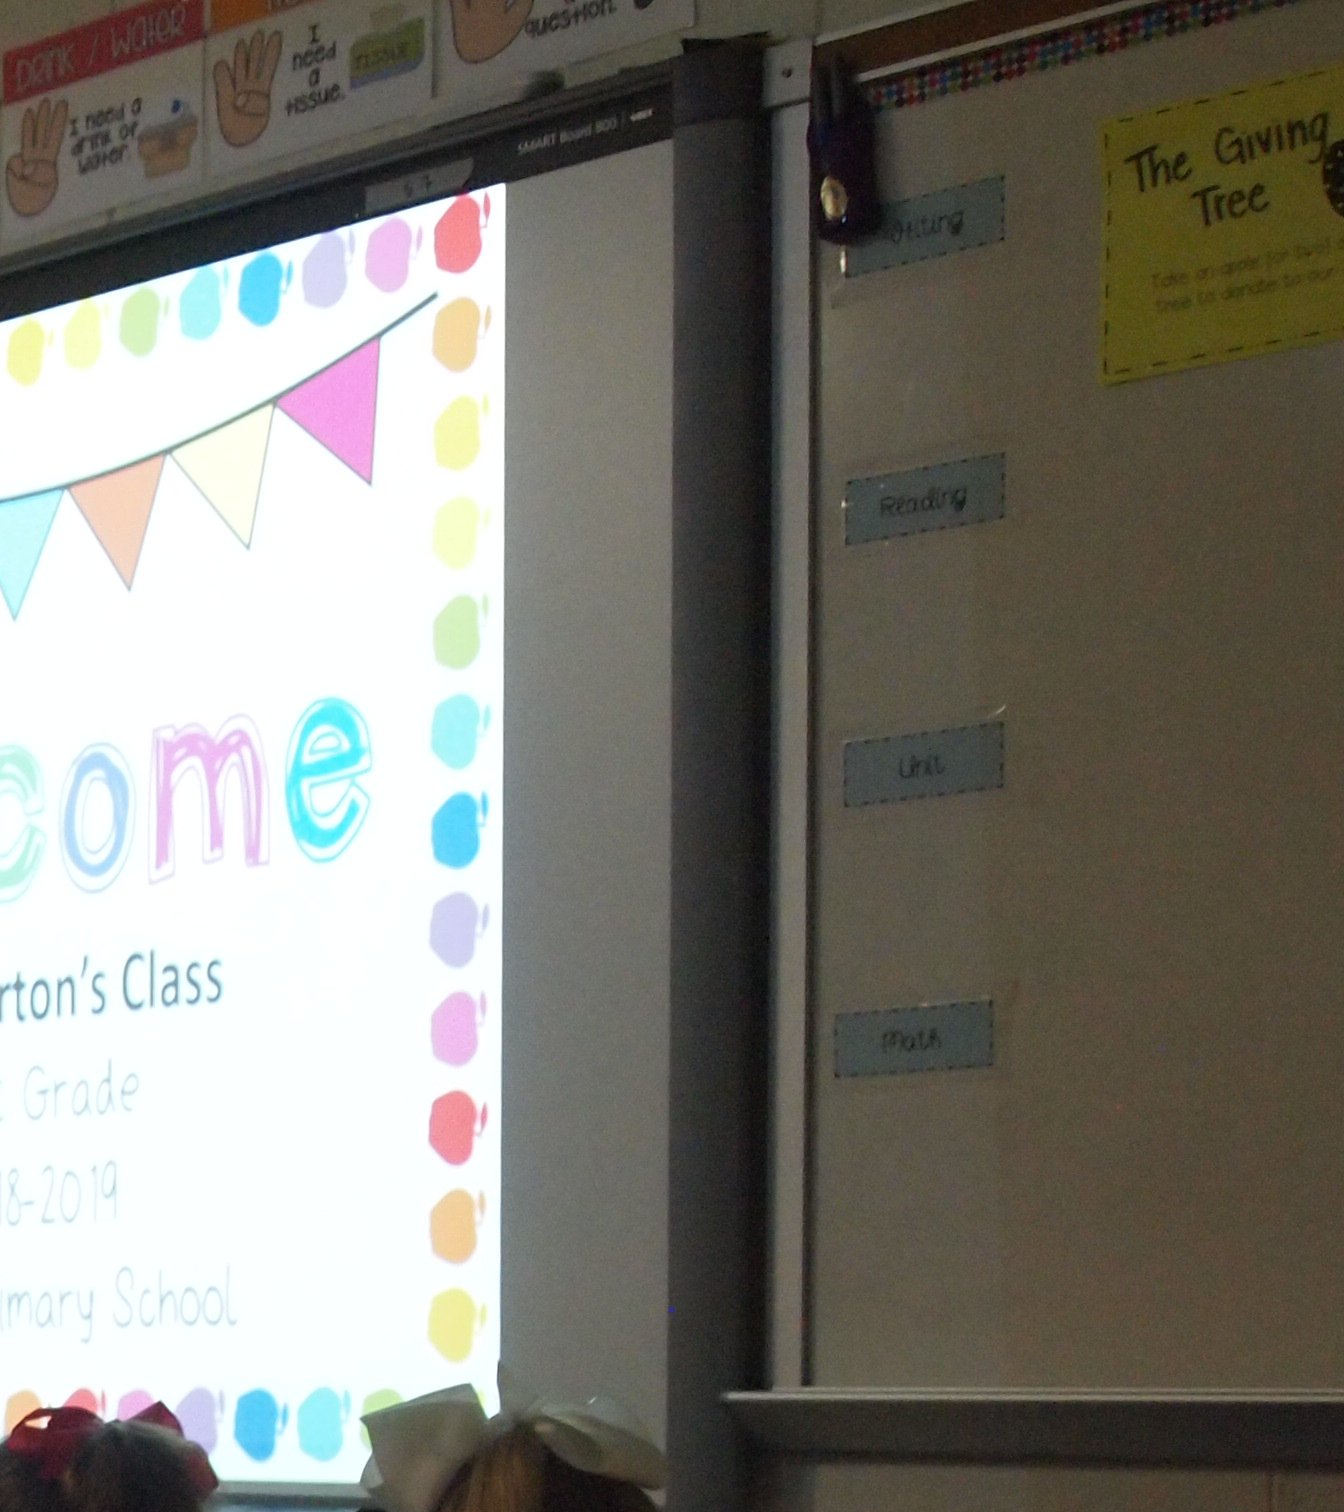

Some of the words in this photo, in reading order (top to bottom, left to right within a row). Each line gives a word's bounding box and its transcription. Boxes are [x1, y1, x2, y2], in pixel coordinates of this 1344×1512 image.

[292, 41, 337, 71] need
[309, 68, 320, 87] a
[86, 102, 125, 129] need
[131, 97, 142, 115] a
[1124, 143, 1193, 192] The
[1215, 111, 1329, 165] Giving
[1191, 182, 1270, 227] Tree
[880, 486, 968, 517] Reading
[898, 751, 946, 780] Unit
[122, 949, 224, 1013] Class
[881, 1027, 943, 1054] Math
[23, 1056, 140, 1121] Grade
[112, 1262, 239, 1328] School
